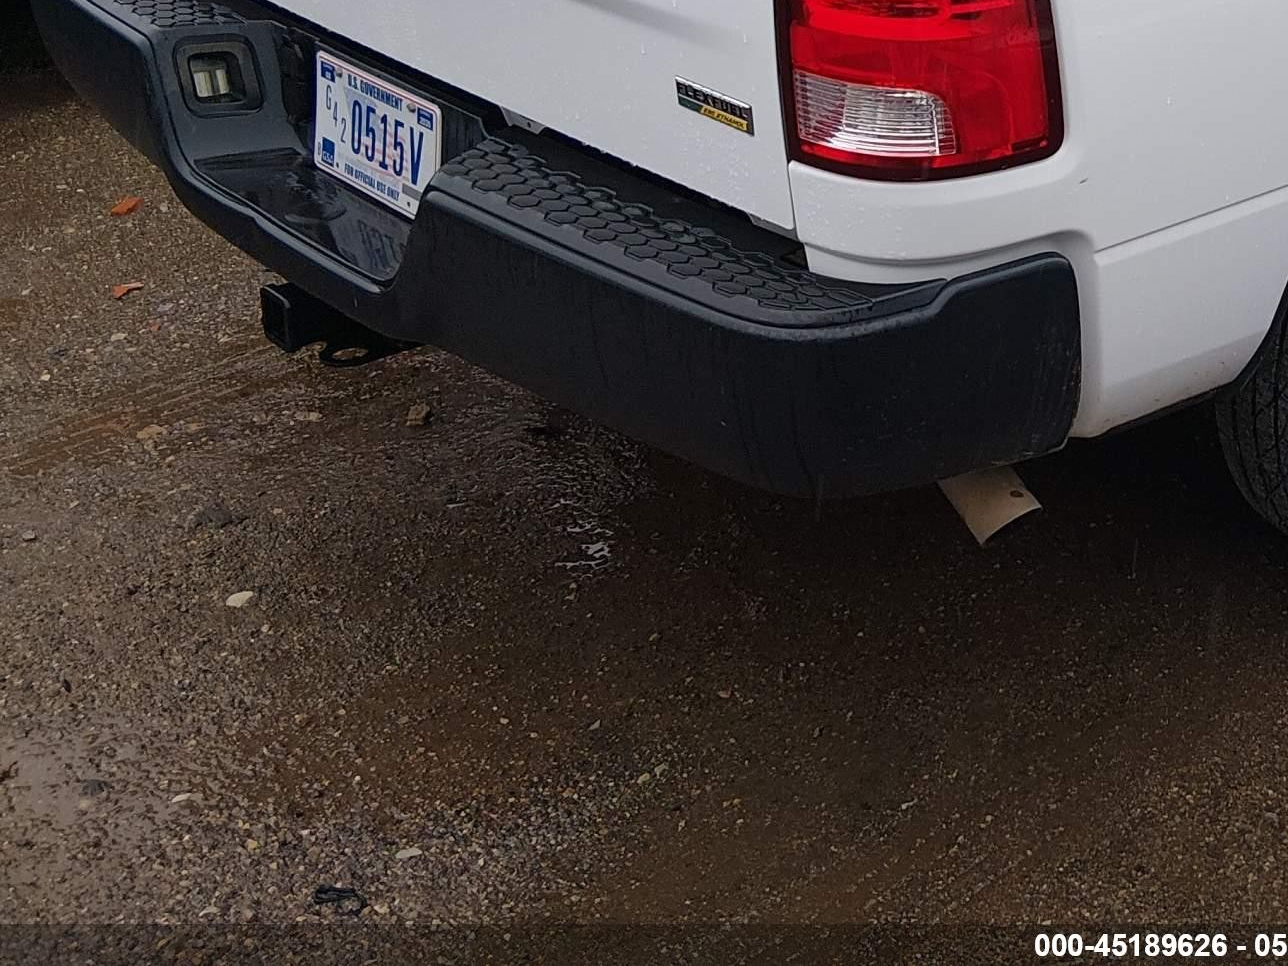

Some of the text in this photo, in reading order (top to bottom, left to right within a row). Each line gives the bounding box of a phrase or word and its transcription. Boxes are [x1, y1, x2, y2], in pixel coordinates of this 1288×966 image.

[347, 73, 403, 111] U.S. GOVERNMENT
[351, 99, 424, 186] 0515V
[354, 169, 376, 189] OFFICIAL
[387, 186, 400, 201] ONLY
